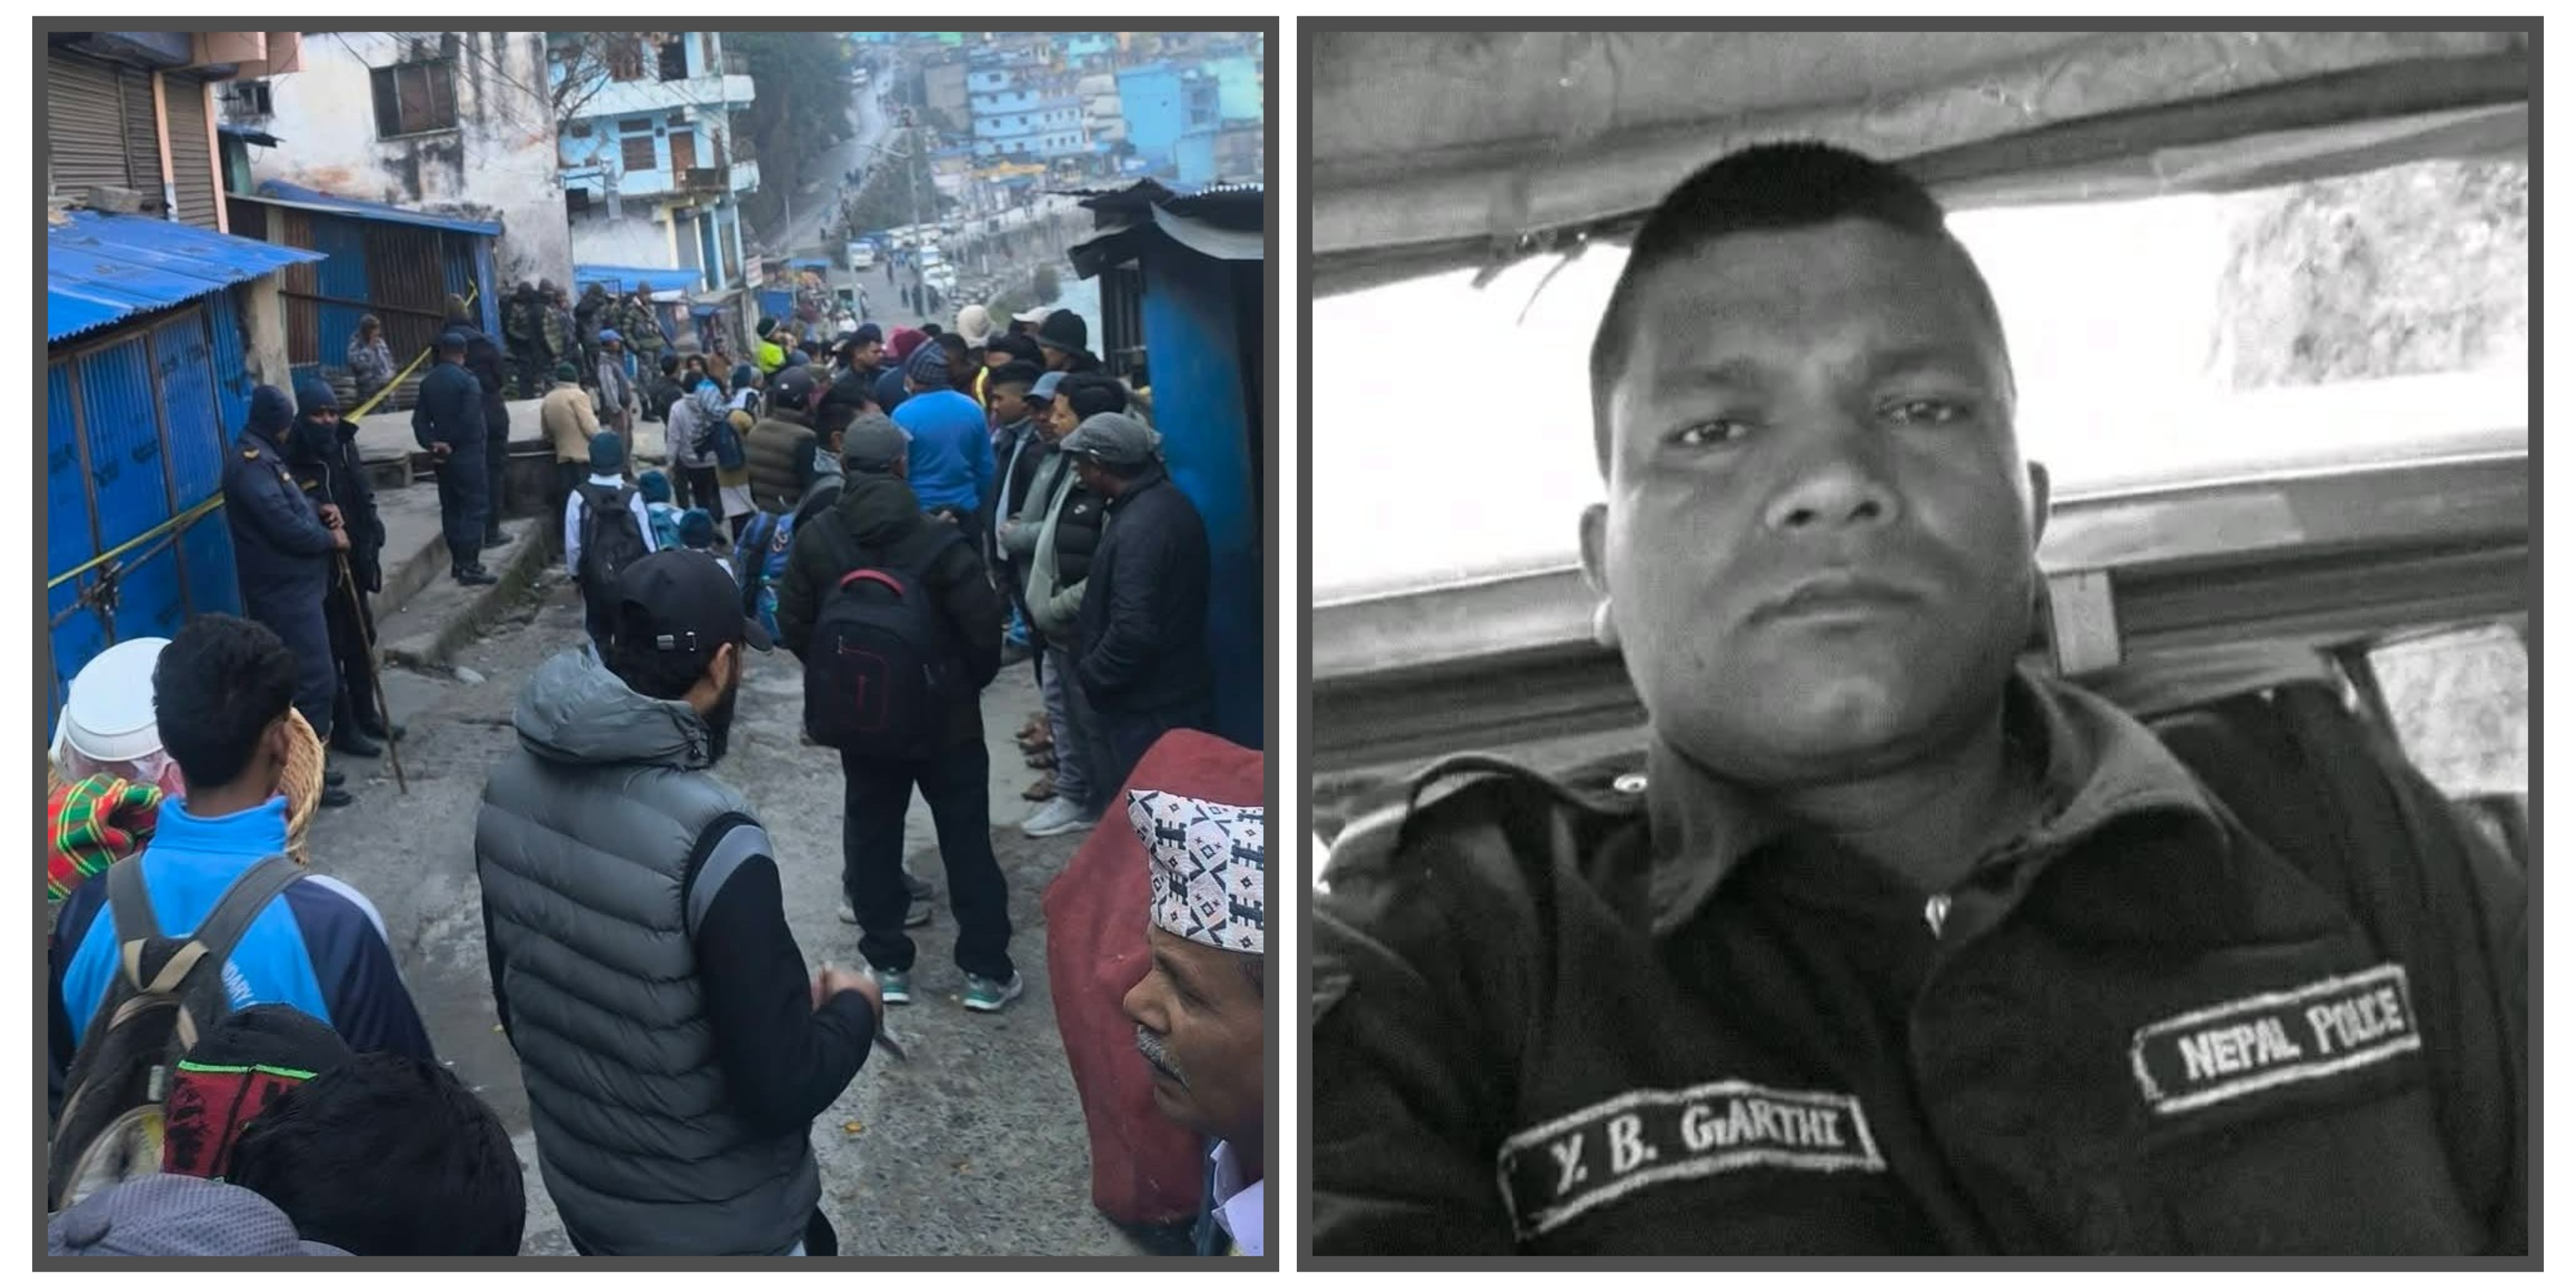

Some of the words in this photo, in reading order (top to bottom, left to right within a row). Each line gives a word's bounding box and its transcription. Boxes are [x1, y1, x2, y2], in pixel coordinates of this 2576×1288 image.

[2178, 1017, 2302, 1080] NEPAL
[2305, 987, 2404, 1054] POLICE
[1551, 1133, 1587, 1193] Y.
[1608, 1114, 1657, 1174] B.
